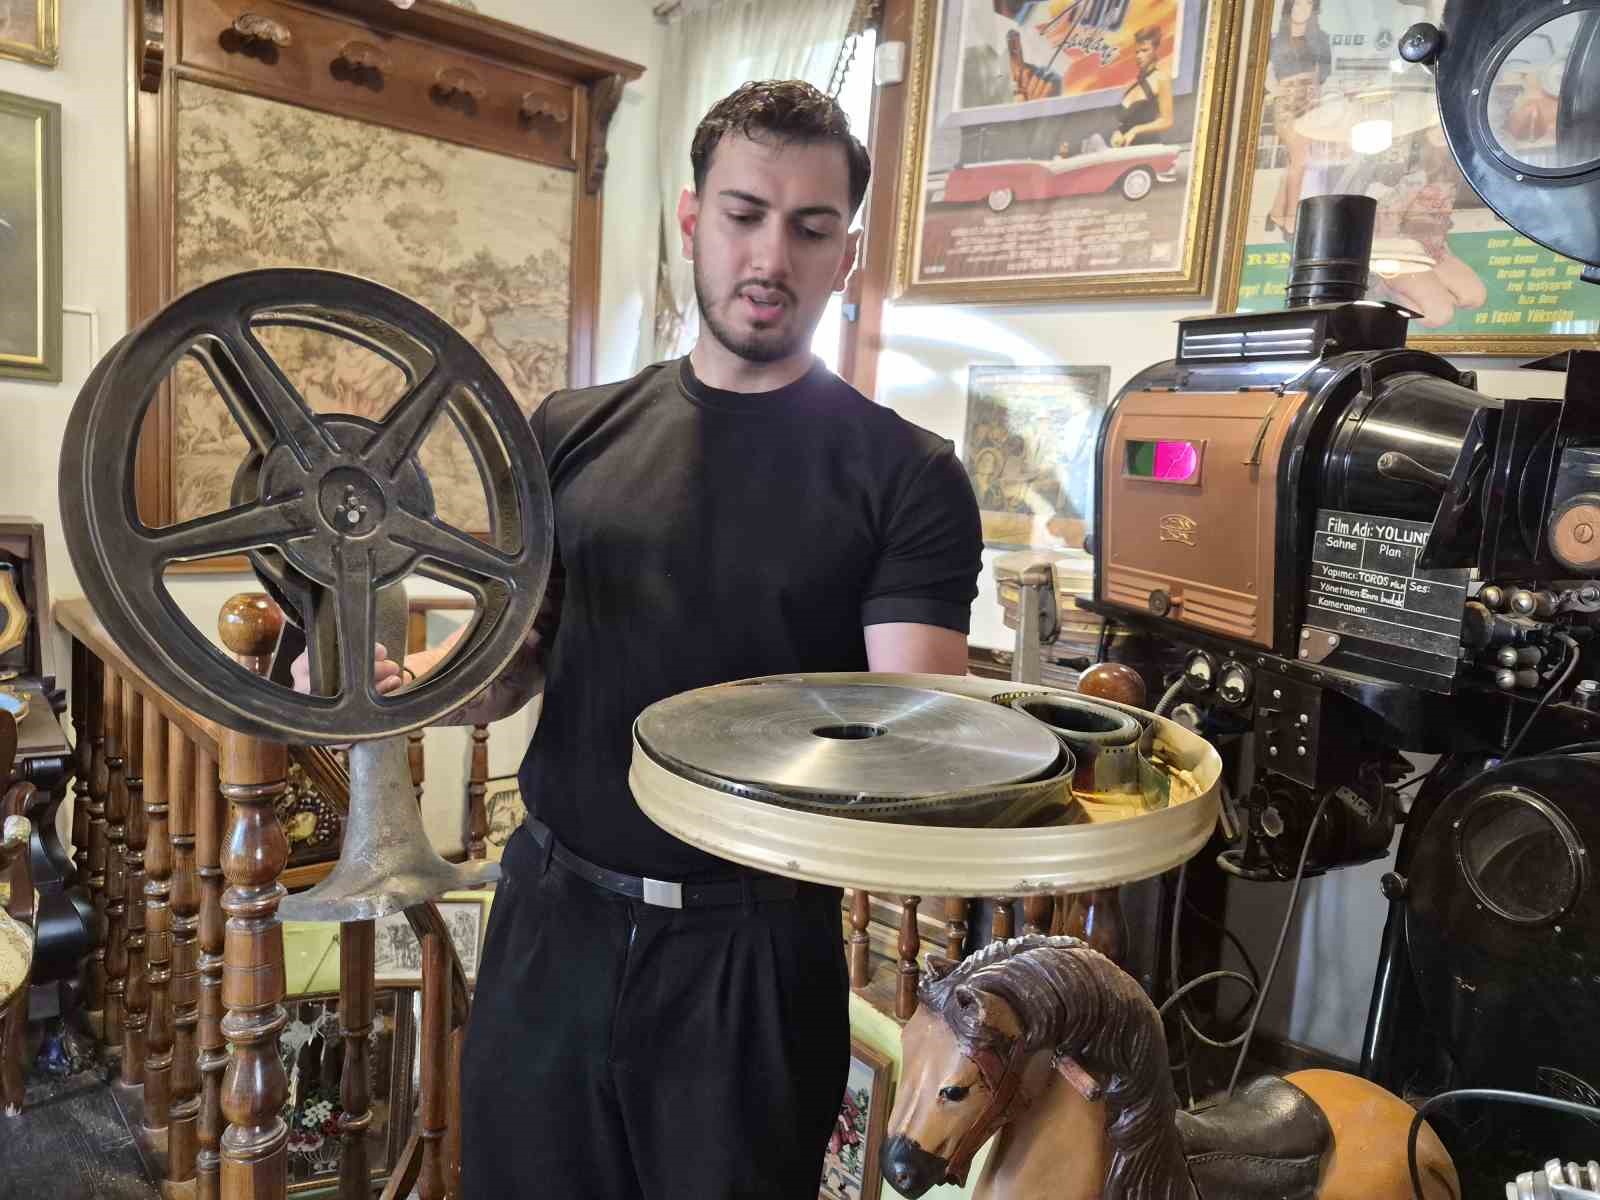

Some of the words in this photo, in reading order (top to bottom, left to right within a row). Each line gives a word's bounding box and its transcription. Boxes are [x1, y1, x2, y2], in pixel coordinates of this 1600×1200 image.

[1328, 517, 1349, 535] Film
[1353, 522, 1373, 537] Adı:
[1326, 537, 1357, 550] Sahne
[1379, 544, 1402, 558] Plan
[1358, 571, 1390, 586] TOROS
[1409, 581, 1430, 593] Ses:
[1319, 598, 1367, 614] Kameraman:
